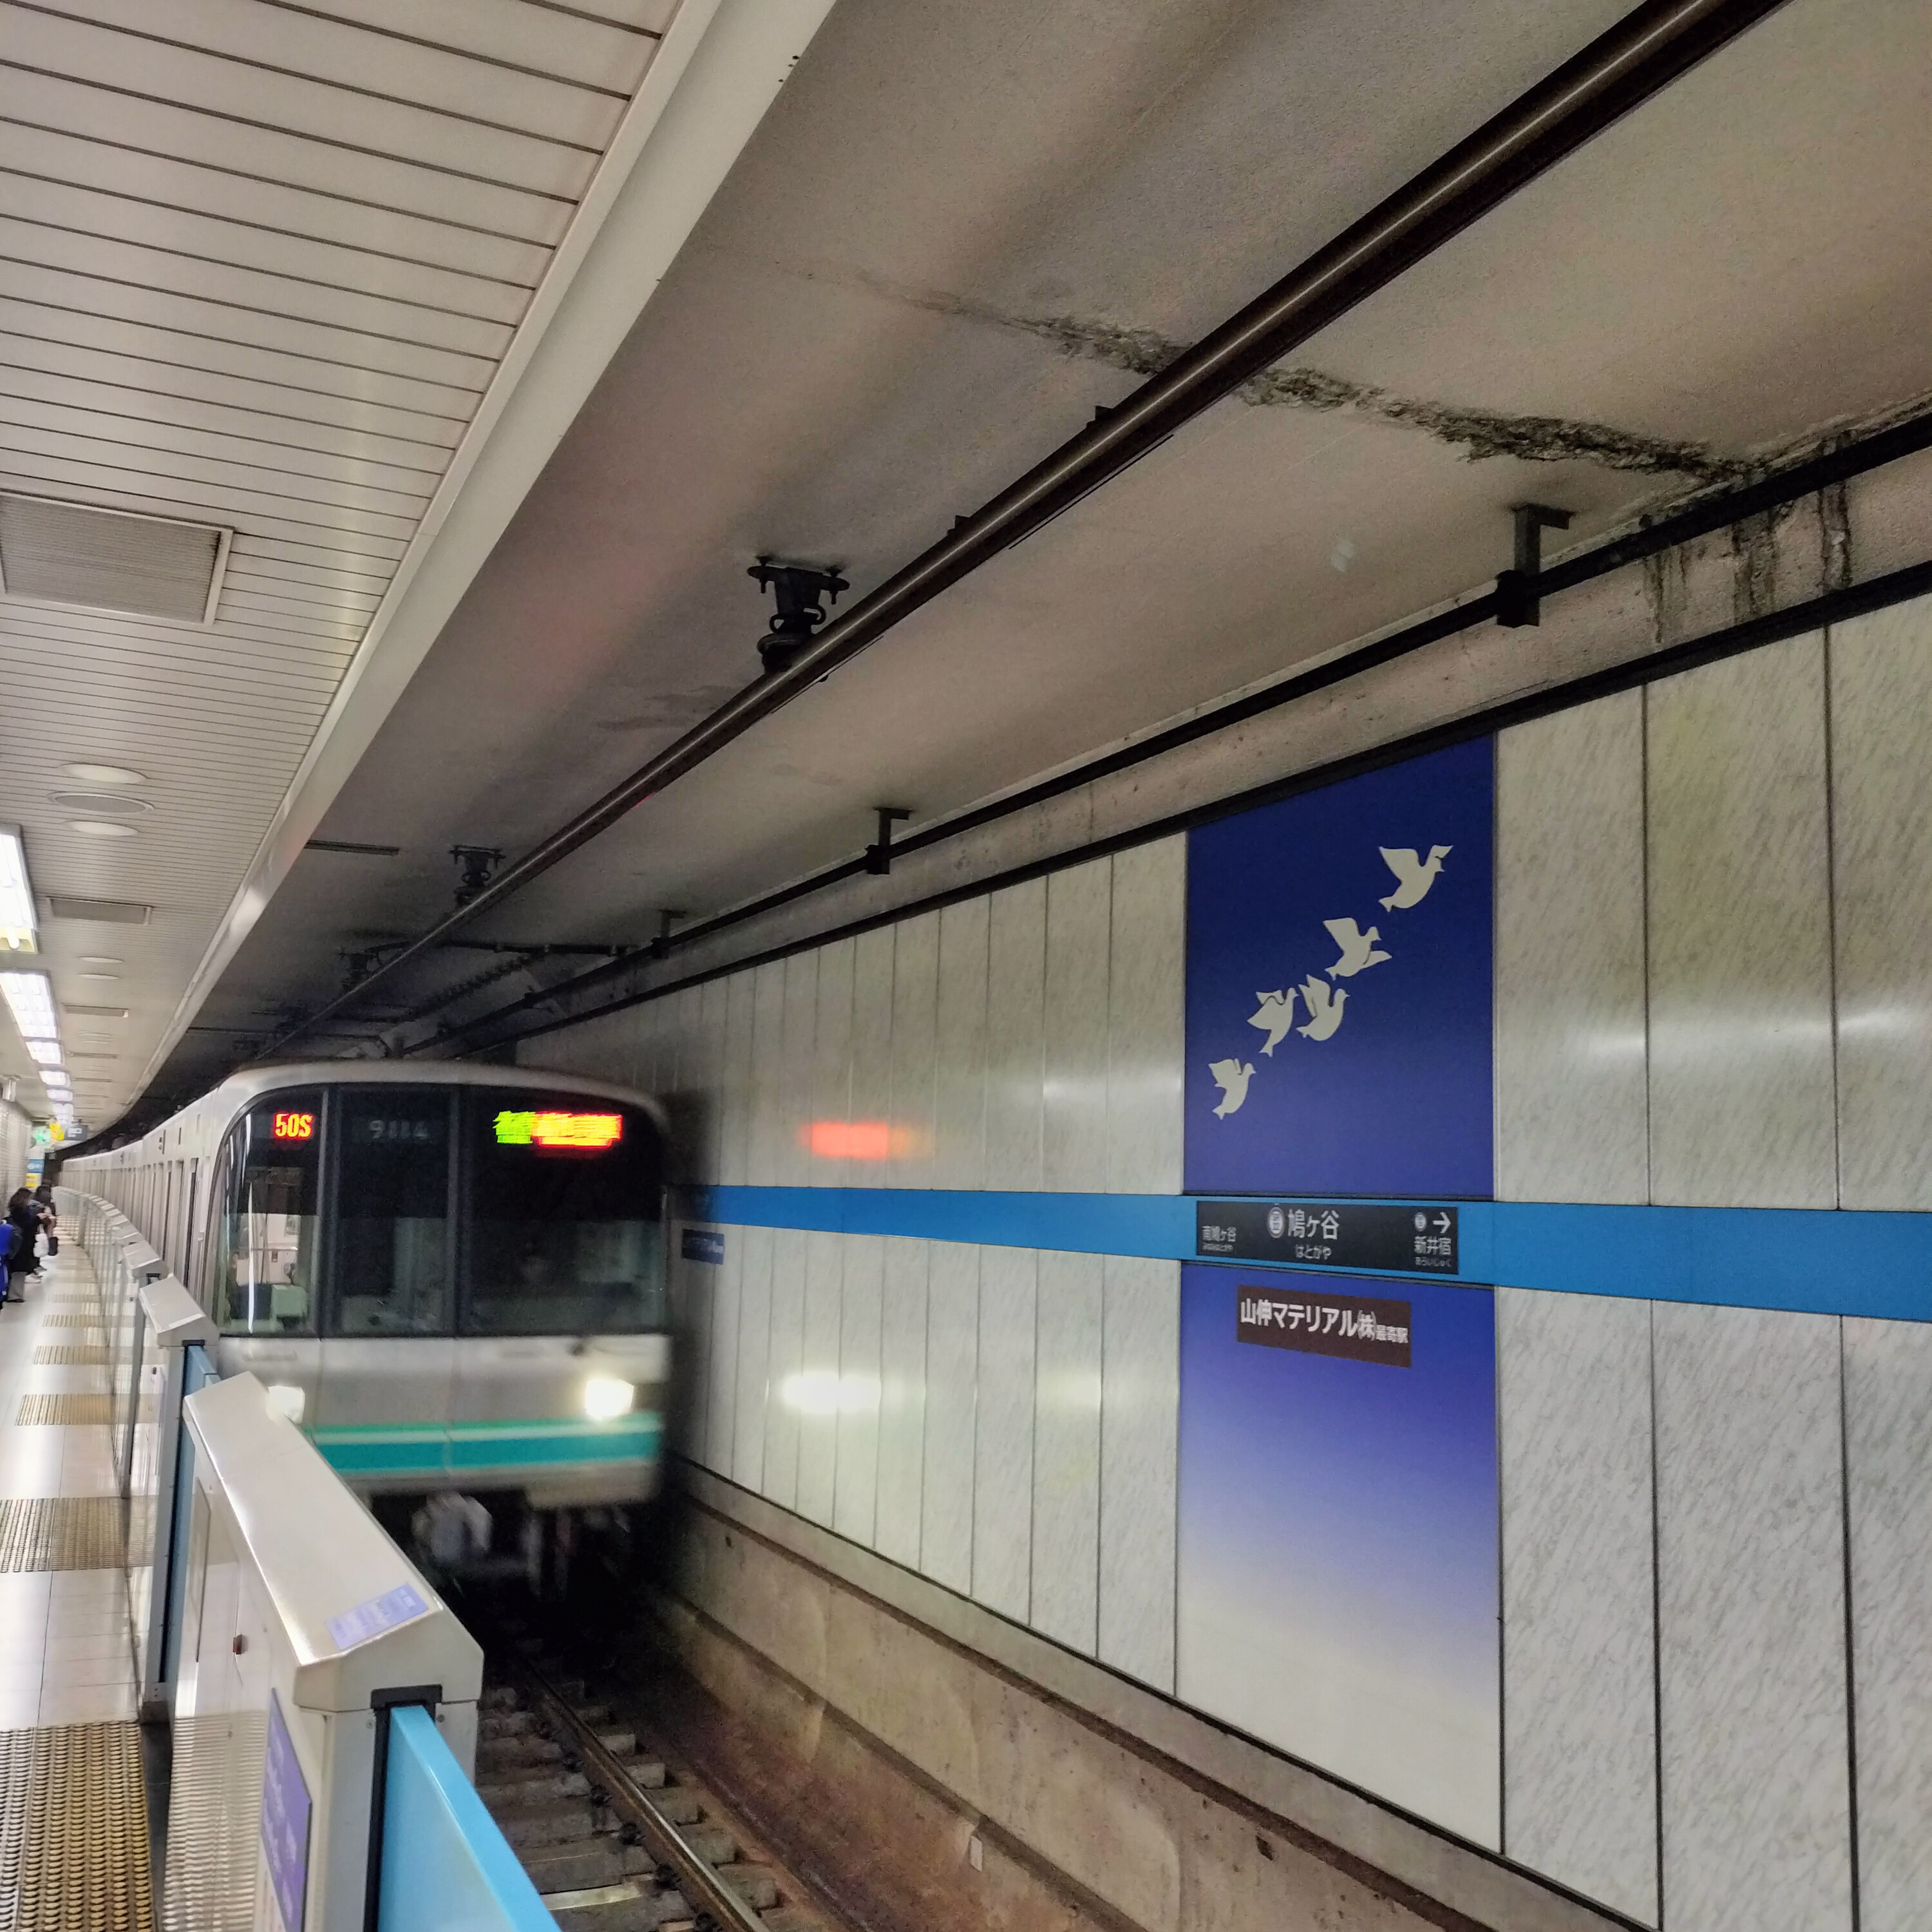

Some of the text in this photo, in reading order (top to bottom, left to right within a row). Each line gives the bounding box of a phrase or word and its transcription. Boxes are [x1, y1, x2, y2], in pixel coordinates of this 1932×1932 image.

[274, 1113, 313, 1139] 50S
[1288, 1208, 1340, 1240] 鳩ヶ谷
[1295, 1244, 1332, 1260] はとがや
[1414, 1236, 1452, 1256] 新井宿
